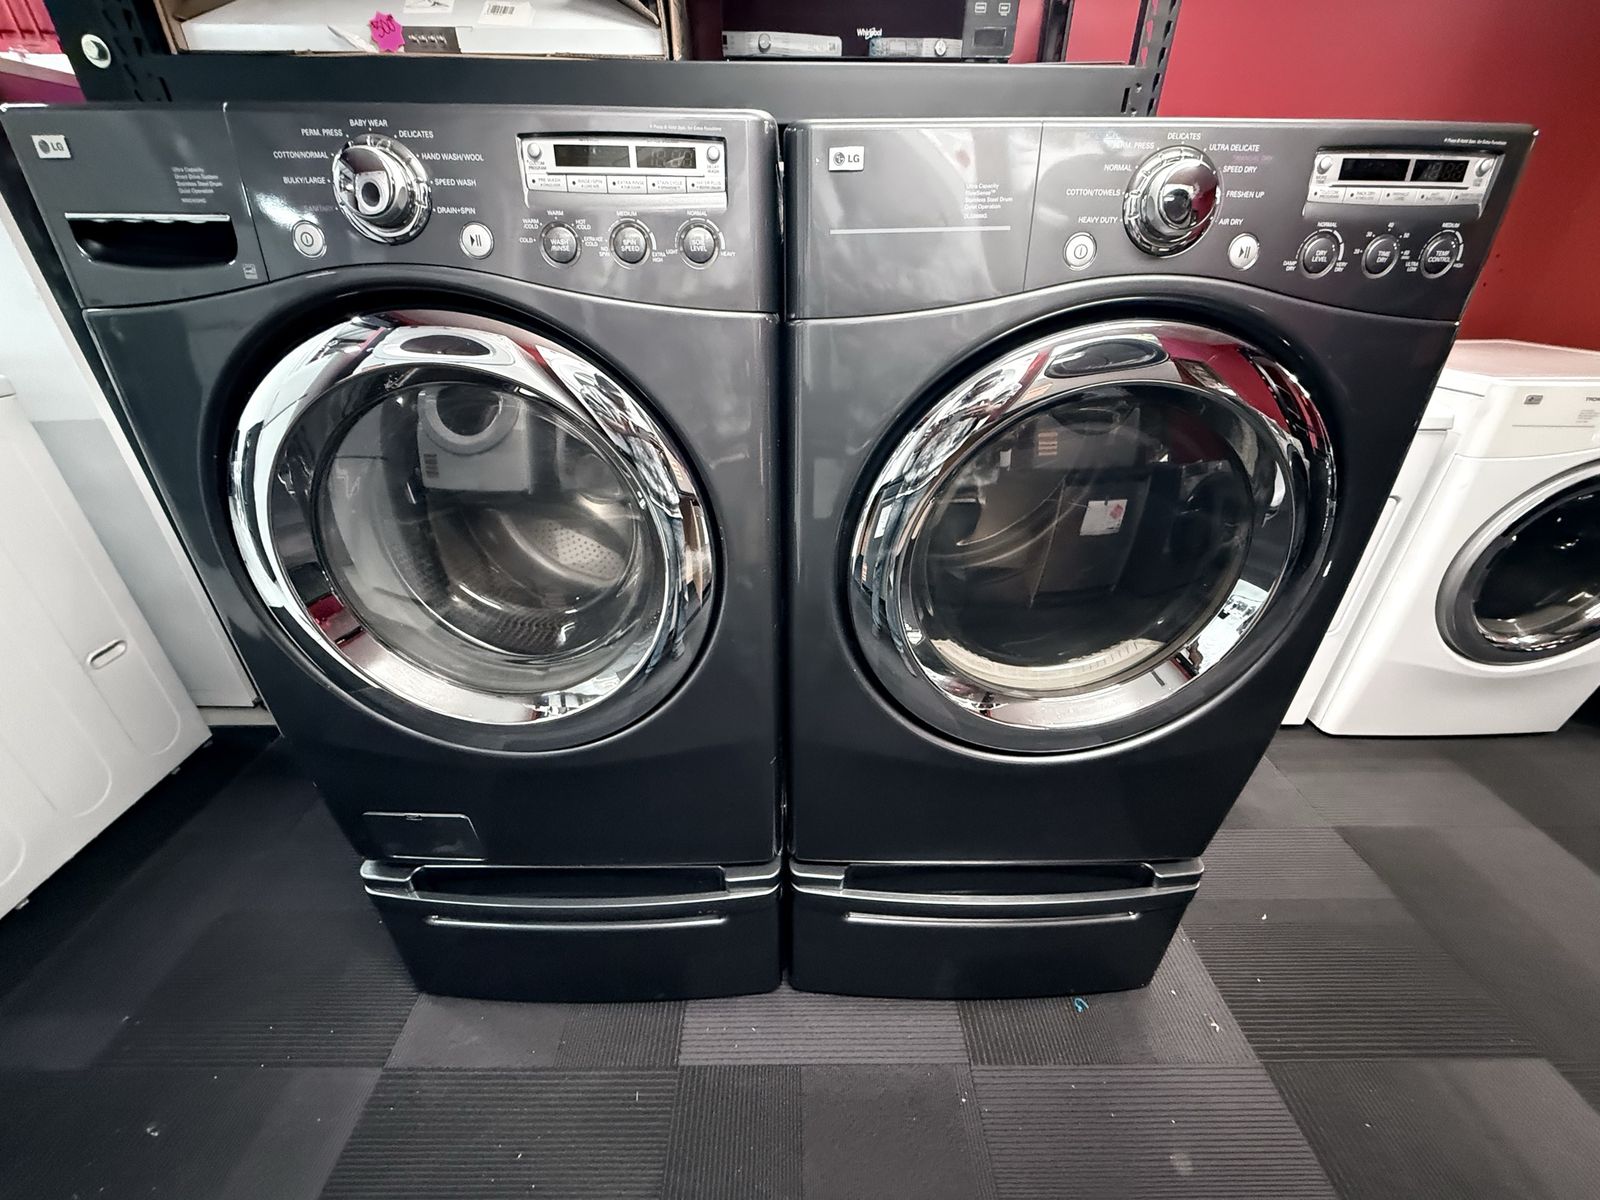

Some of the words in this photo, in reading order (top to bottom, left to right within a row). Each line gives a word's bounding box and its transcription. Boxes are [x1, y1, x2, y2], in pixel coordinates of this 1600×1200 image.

[857, 27, 882, 40] Whirlpool
[349, 119, 367, 127] BABY
[368, 119, 388, 127] WEAR
[322, 129, 343, 137] PRESS
[398, 130, 434, 138] DELICATES
[1167, 132, 1201, 140] DELICATES
[1230, 144, 1260, 152] DELICATE
[273, 151, 328, 159] COTTON/NORMAL
[421, 152, 441, 160] HAND
[441, 153, 484, 161] WASH/WOOL
[1103, 164, 1132, 172] NORMAL
[283, 176, 326, 184] BULKY/LARGE
[434, 178, 456, 186] SPEED
[457, 179, 477, 187] WASH
[1066, 188, 1121, 197] COTTON/TOWELS
[1226, 190, 1254, 198] FRESHEN
[437, 206, 476, 214] DRAIN+SPIN
[1078, 216, 1099, 224] HEAVY
[1230, 218, 1244, 226] DRY
